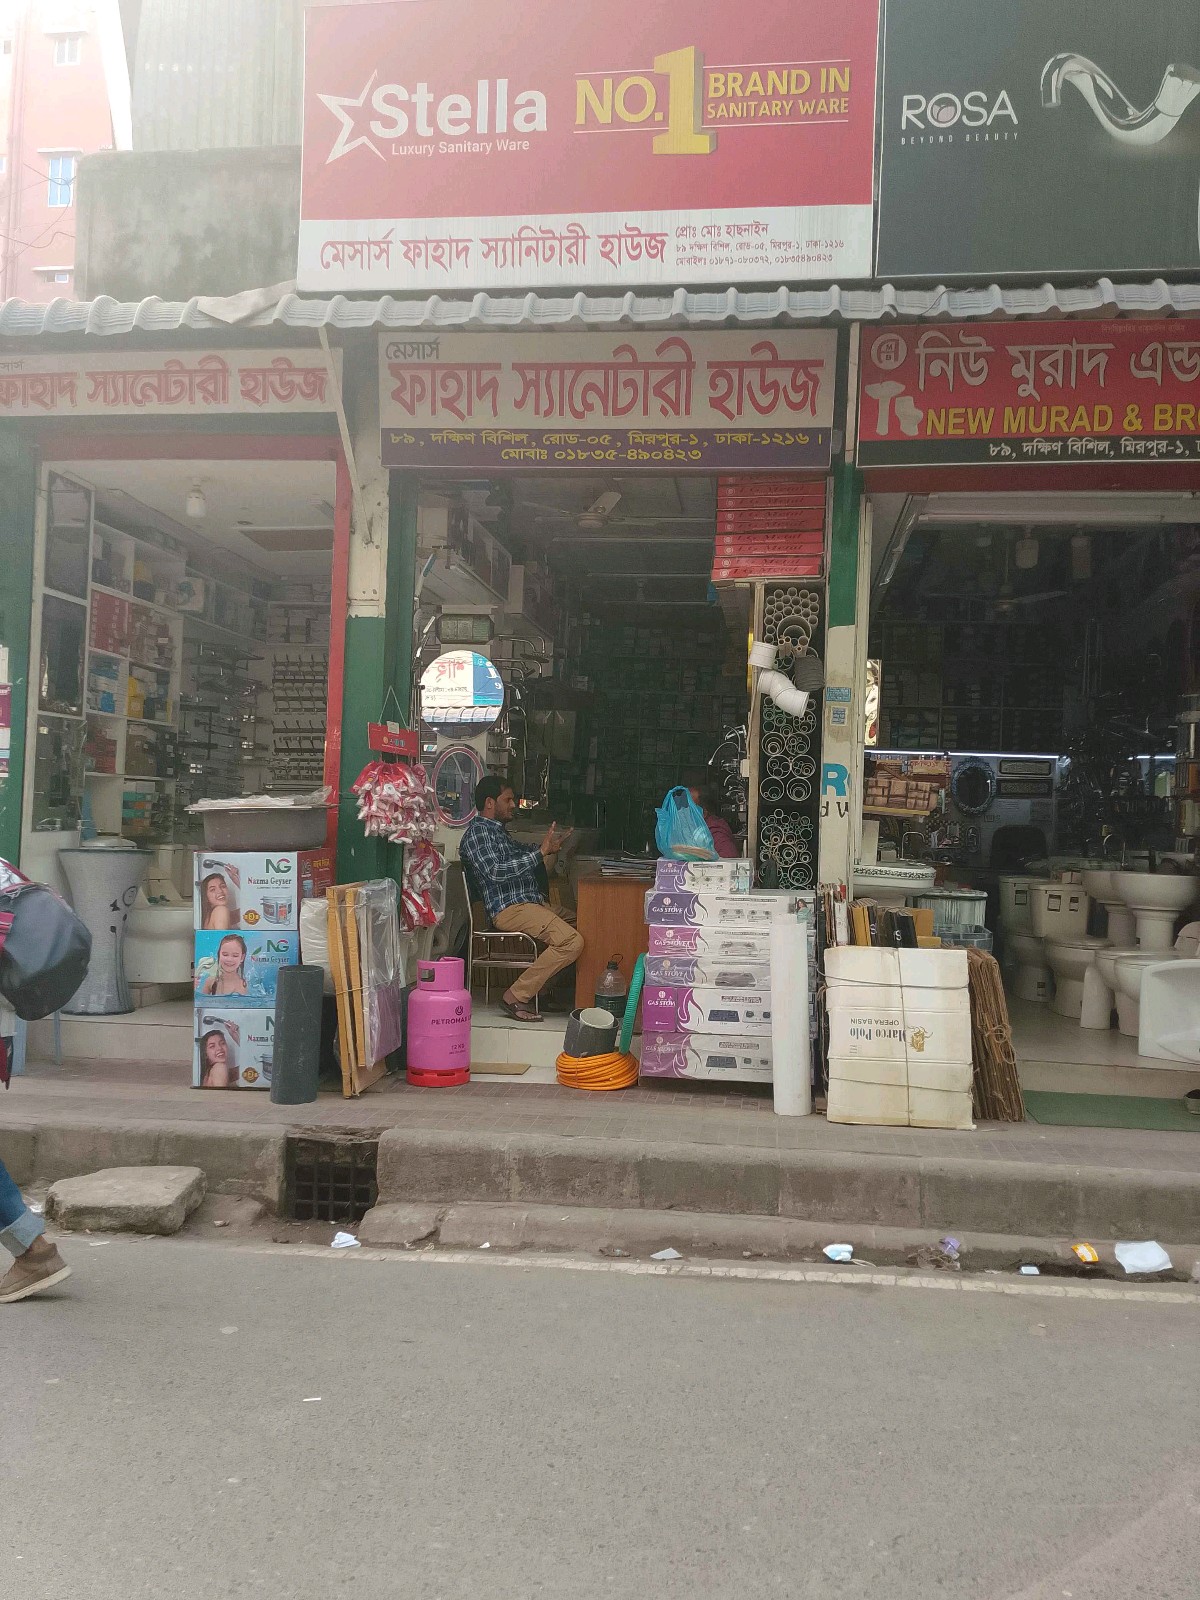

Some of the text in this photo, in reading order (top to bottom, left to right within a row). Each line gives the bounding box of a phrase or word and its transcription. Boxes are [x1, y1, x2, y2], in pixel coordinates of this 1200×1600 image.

[708, 67, 850, 98] BRAND IN
[370, 78, 548, 139] Stella
[707, 98, 849, 119] SANITARY WARE
[901, 90, 1018, 130] ROSA
[391, 138, 530, 158] Luxury Sanitary Ware
[901, 132, 1019, 146] BEYOND BEAUTY
[320, 222, 669, 273] মেসার্স ফাহাদ স্যানিটারী হাউজ
[385, 337, 440, 360] মেসার্স
[915, 329, 997, 392] নিউ
[1005, 337, 1116, 402] মুরাদ
[238, 356, 329, 408] হাউজ
[387, 336, 825, 423] ফাহাদ স্যানেটারী হাউজ
[926, 403, 1200, 436] NEW MURAD & BR
[1022, 437, 1063, 456] দক্ষিণ
[265, 858, 292, 874] NG
[849, 1027, 872, 1041] Polo
[850, 1017, 873, 1025] BASIN
